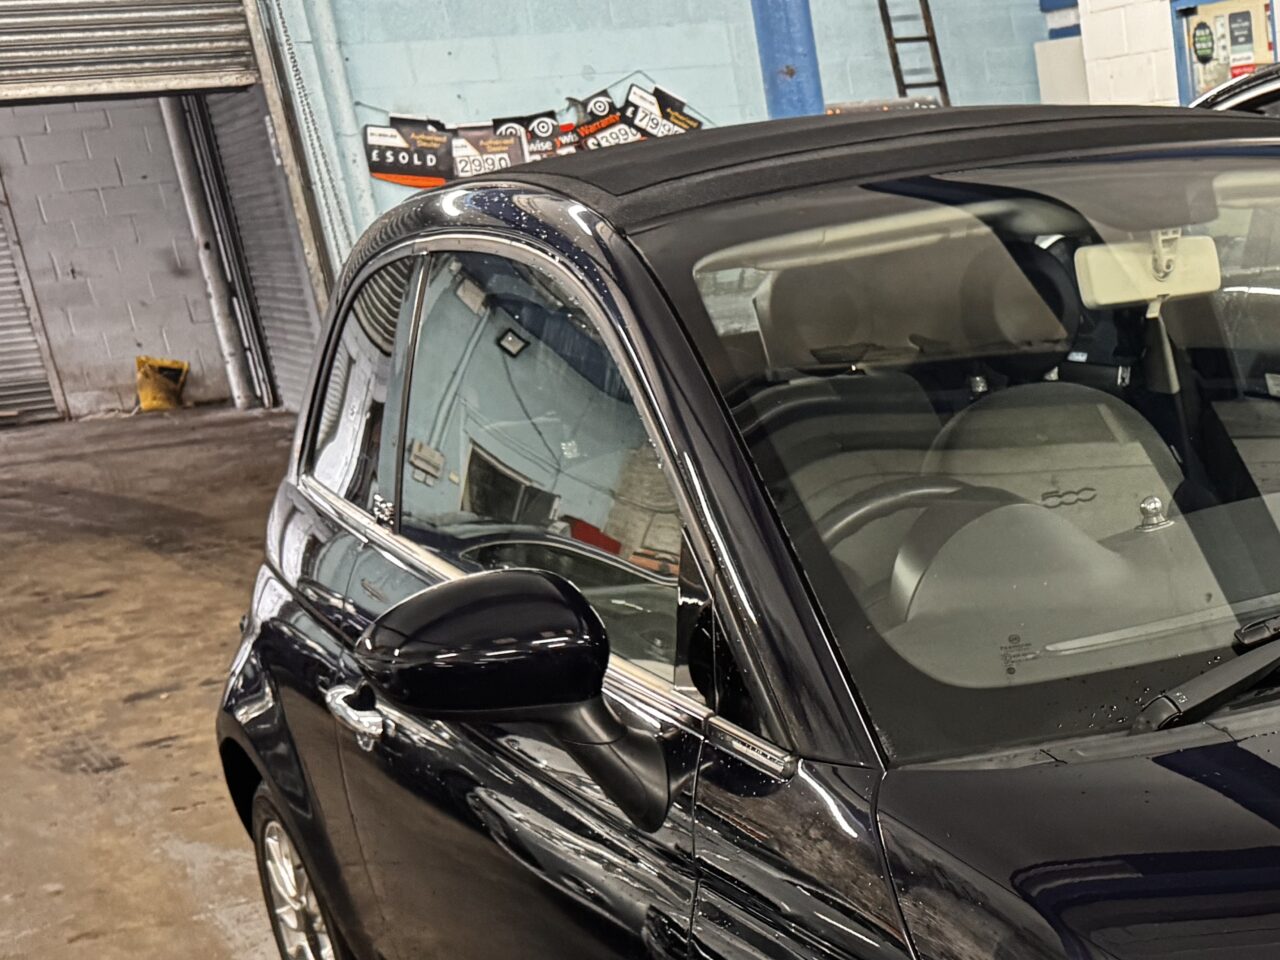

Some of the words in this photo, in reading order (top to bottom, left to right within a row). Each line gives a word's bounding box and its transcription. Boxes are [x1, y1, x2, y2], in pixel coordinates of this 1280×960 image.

[576, 112, 622, 137] Warranty
[385, 150, 437, 167] SOLD
[458, 156, 508, 173] 2990
